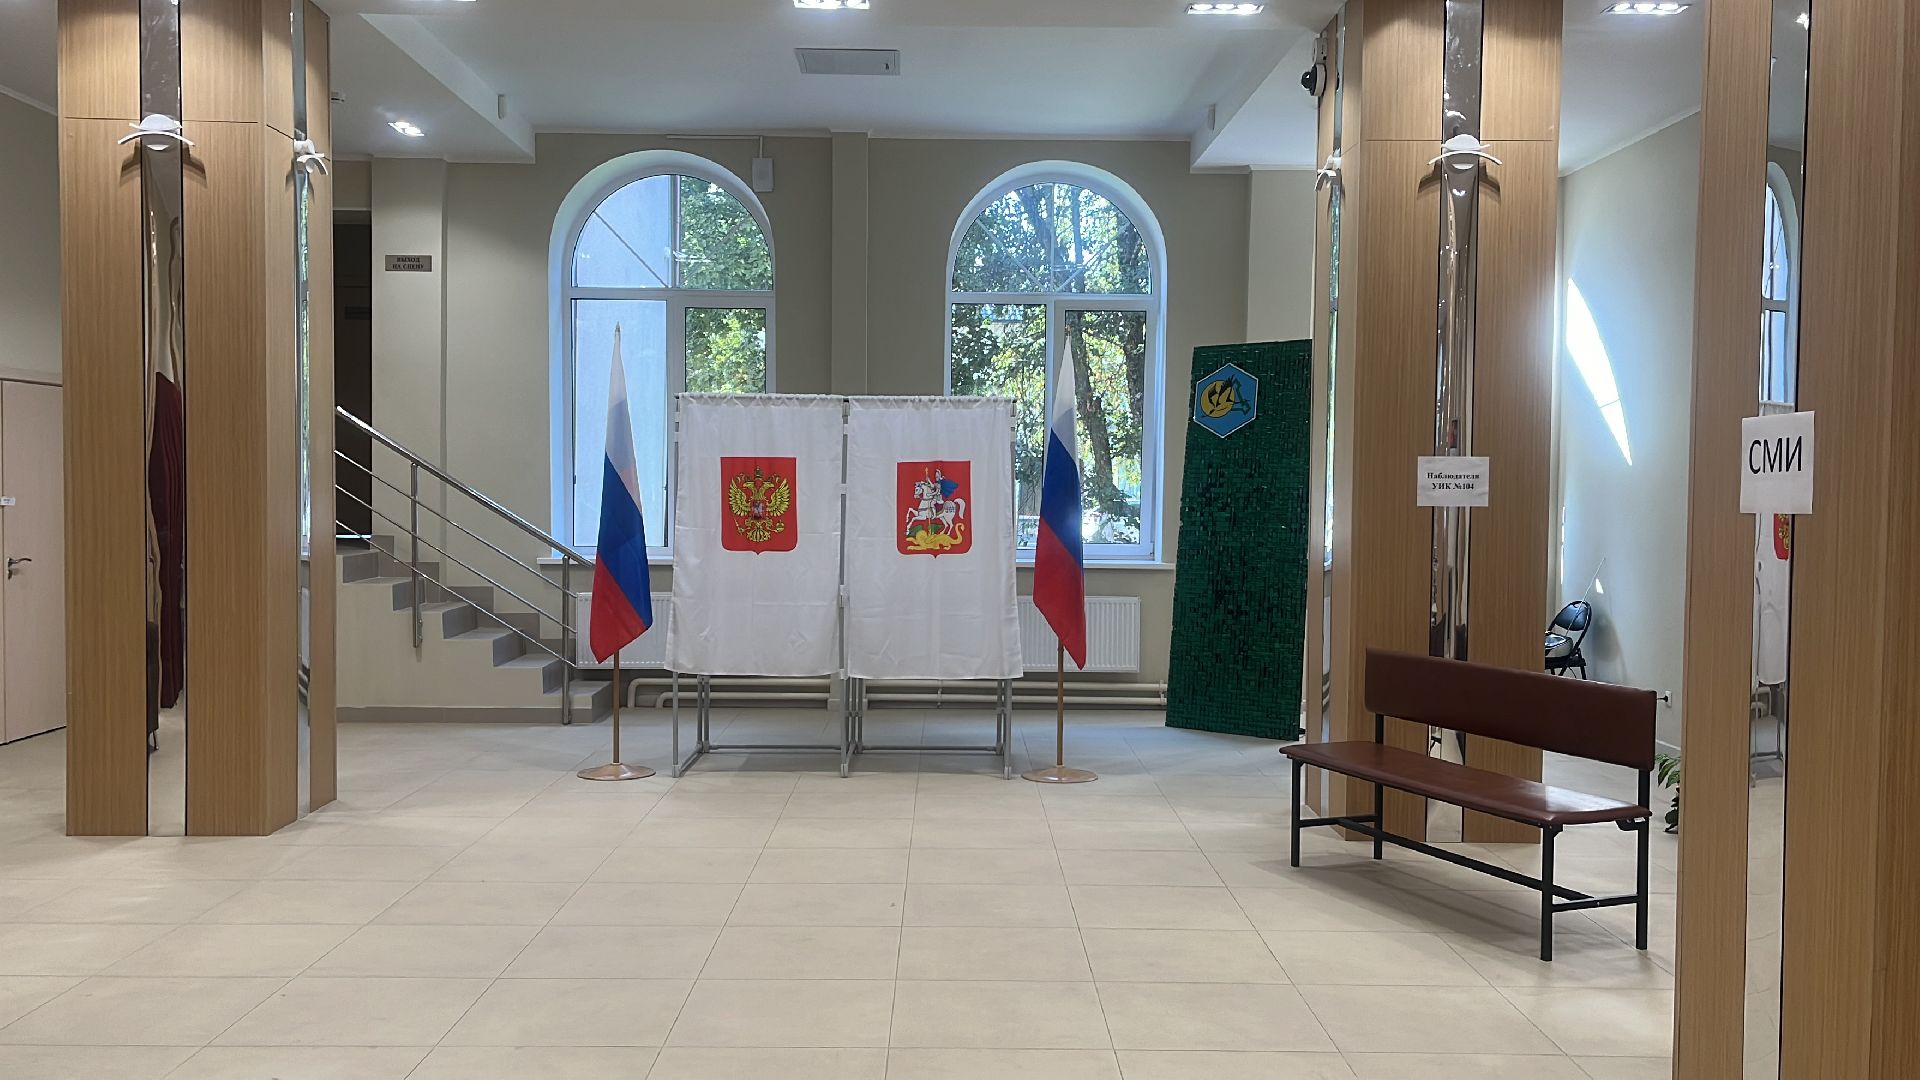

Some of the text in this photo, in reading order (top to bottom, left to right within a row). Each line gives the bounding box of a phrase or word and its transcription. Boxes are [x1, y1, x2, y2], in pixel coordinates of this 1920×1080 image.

[1749, 435, 1802, 475] СМИ
[1427, 472, 1480, 480] Наблюдатели
[1432, 482, 1475, 490] УИК №104
